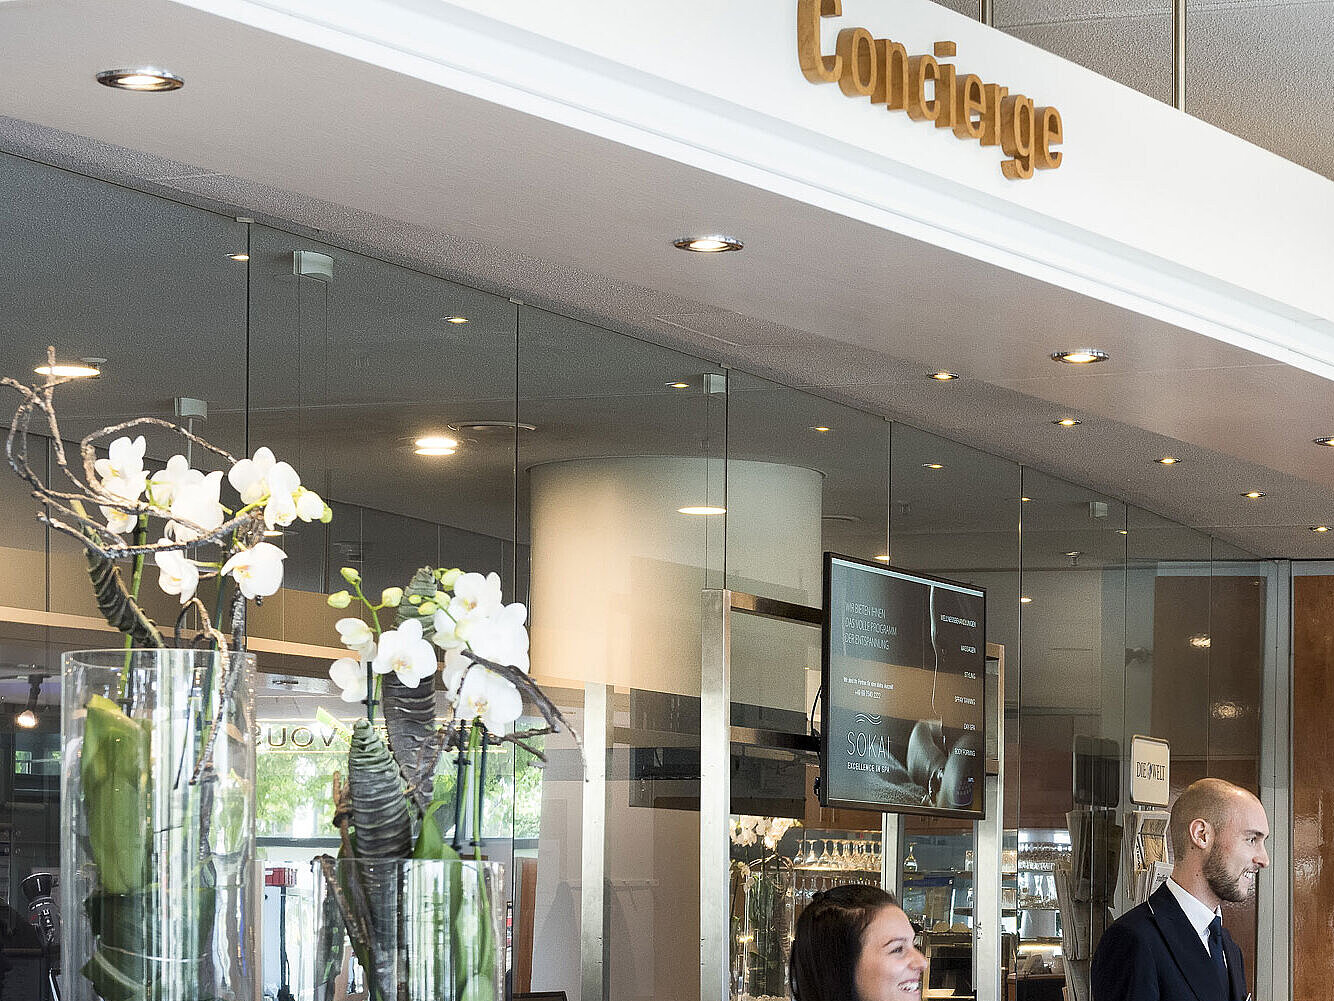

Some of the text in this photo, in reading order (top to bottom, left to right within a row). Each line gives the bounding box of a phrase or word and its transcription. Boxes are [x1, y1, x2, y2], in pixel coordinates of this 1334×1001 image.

[797, 0, 1063, 179] Concierge
[846, 731, 890, 759] SOKAI
[847, 761, 875, 772] EXCELLENCE
[1136, 761, 1166, 781] DIE WELT
